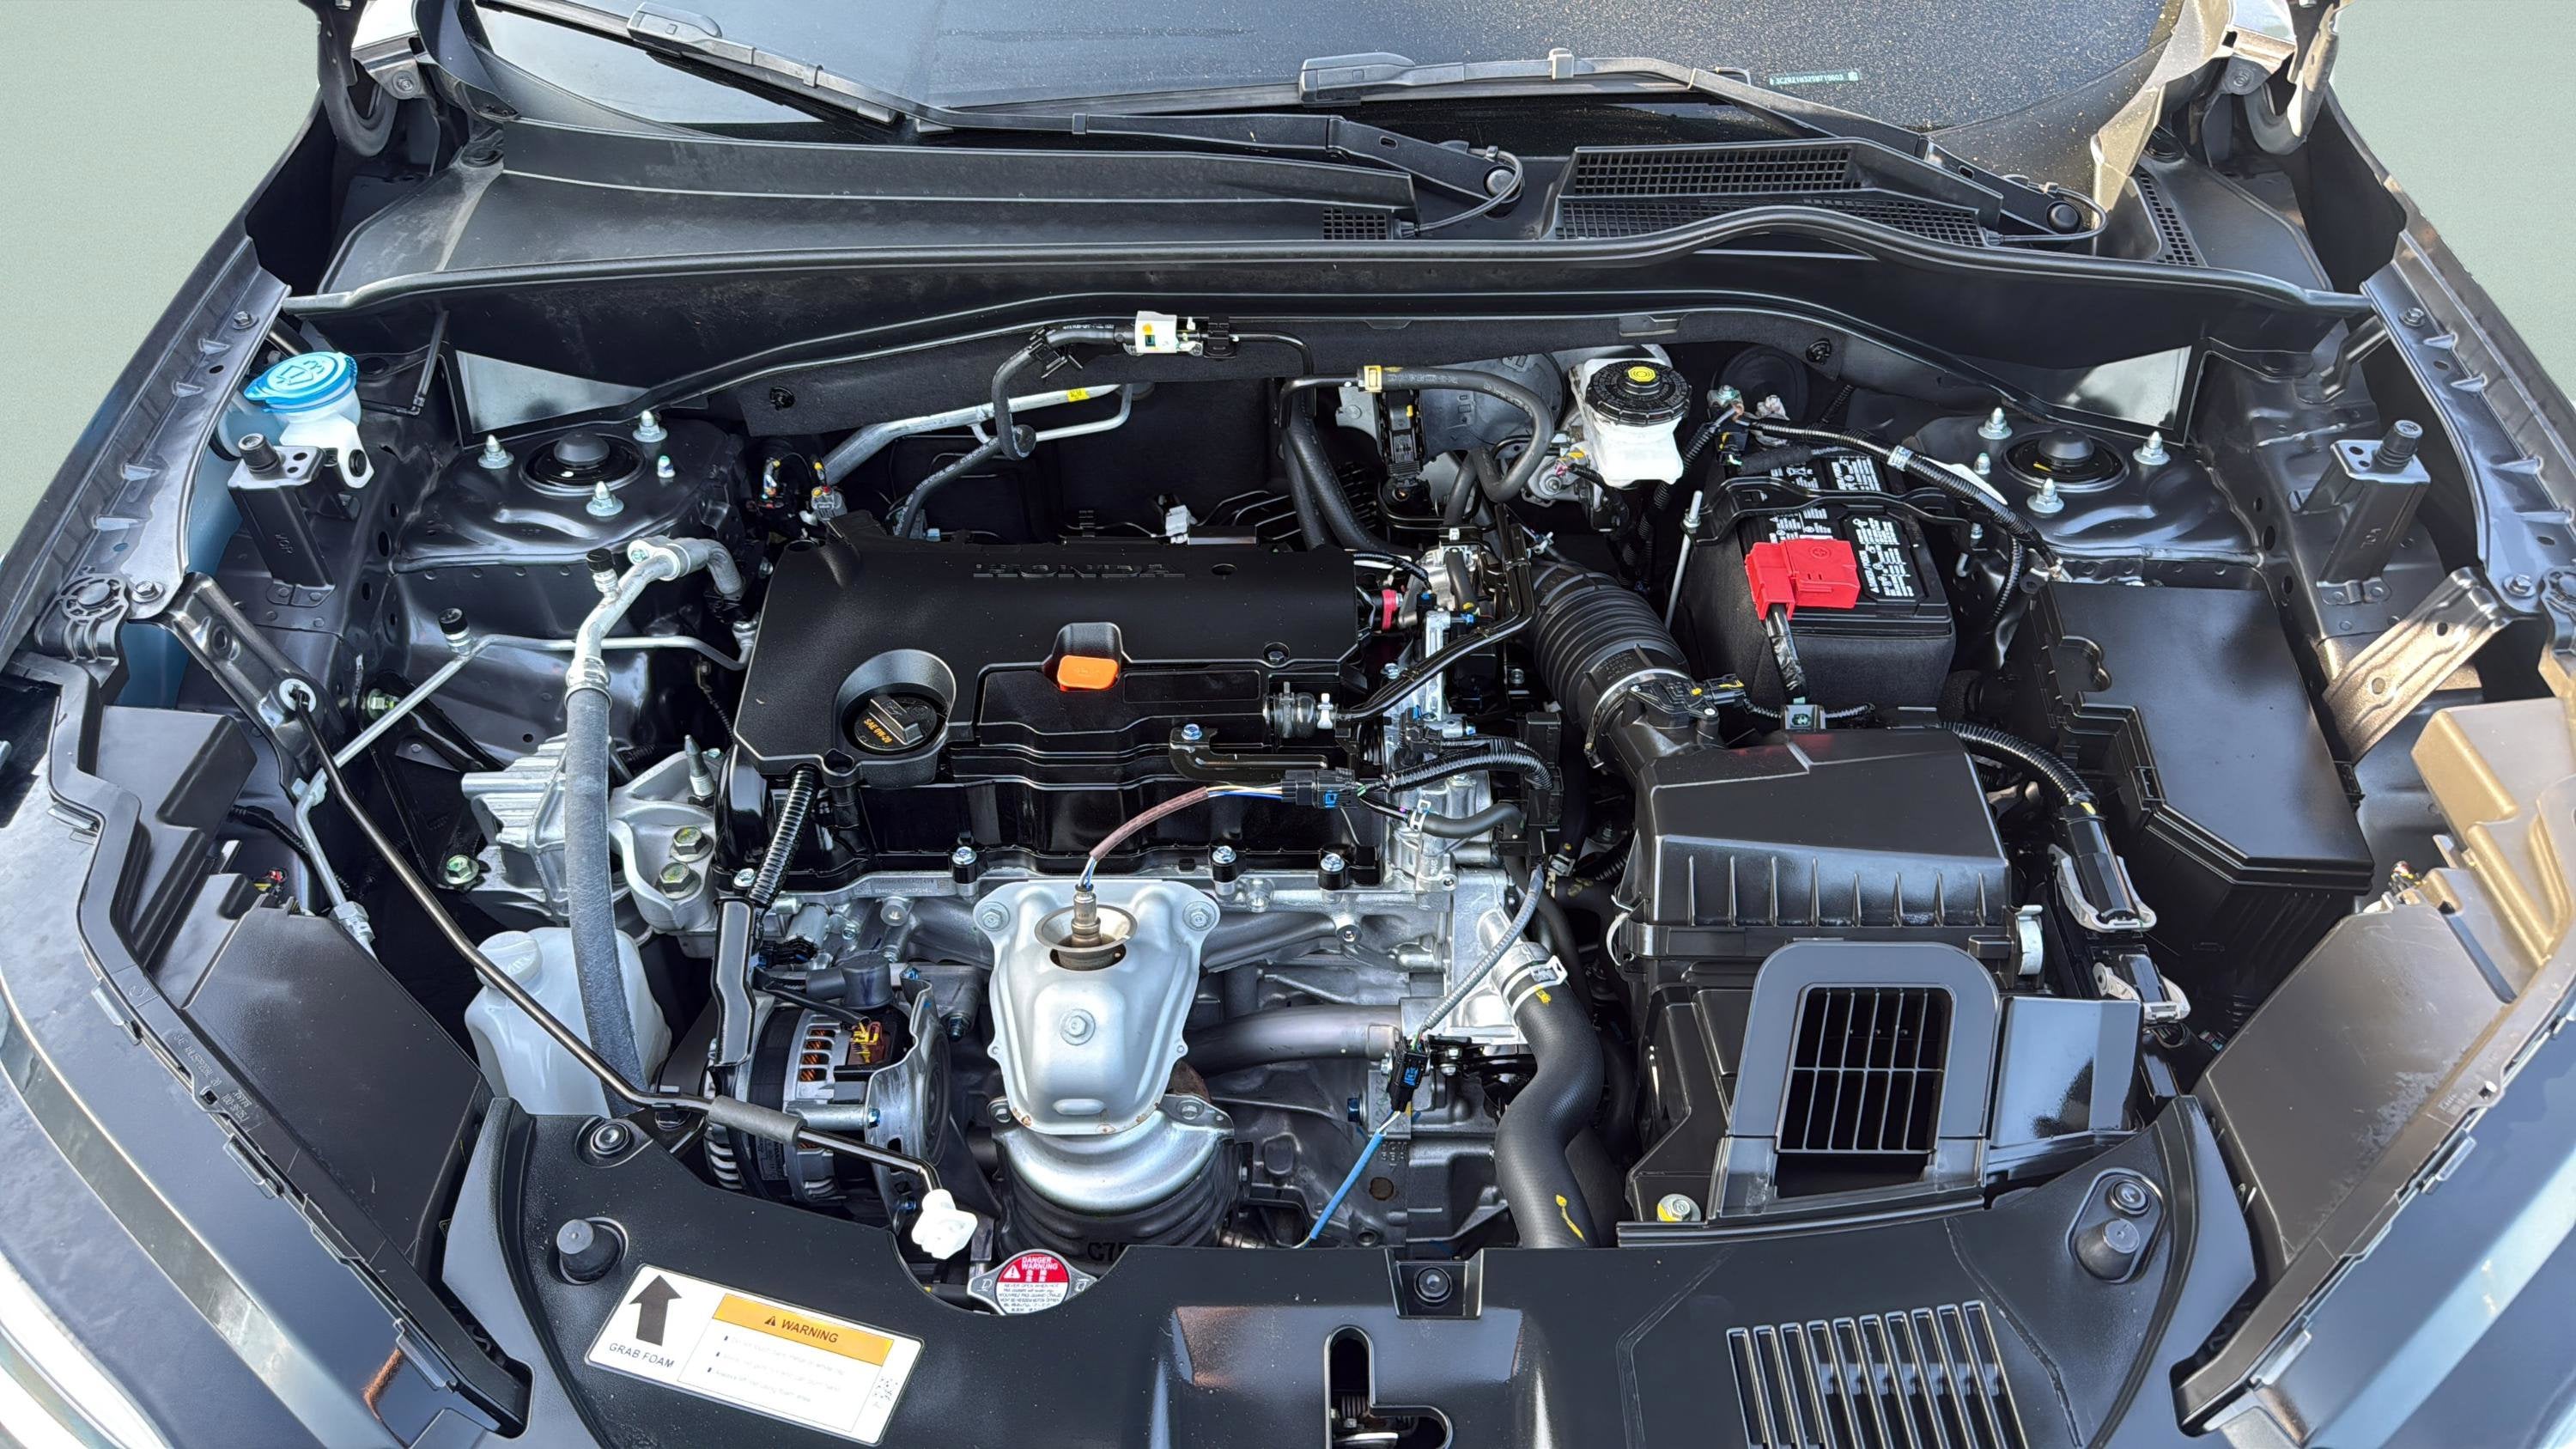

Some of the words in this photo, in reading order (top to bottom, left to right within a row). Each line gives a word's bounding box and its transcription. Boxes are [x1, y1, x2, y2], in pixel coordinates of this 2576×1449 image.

[973, 563, 1186, 578] HONDA
[864, 718, 878, 730] SAE
[873, 728, 893, 744] 0W-20
[1021, 1262, 1059, 1270] WARNUNG
[781, 1319, 839, 1343] WARNING
[609, 1342, 641, 1359] GRAB
[641, 1352, 676, 1368] FOAM
